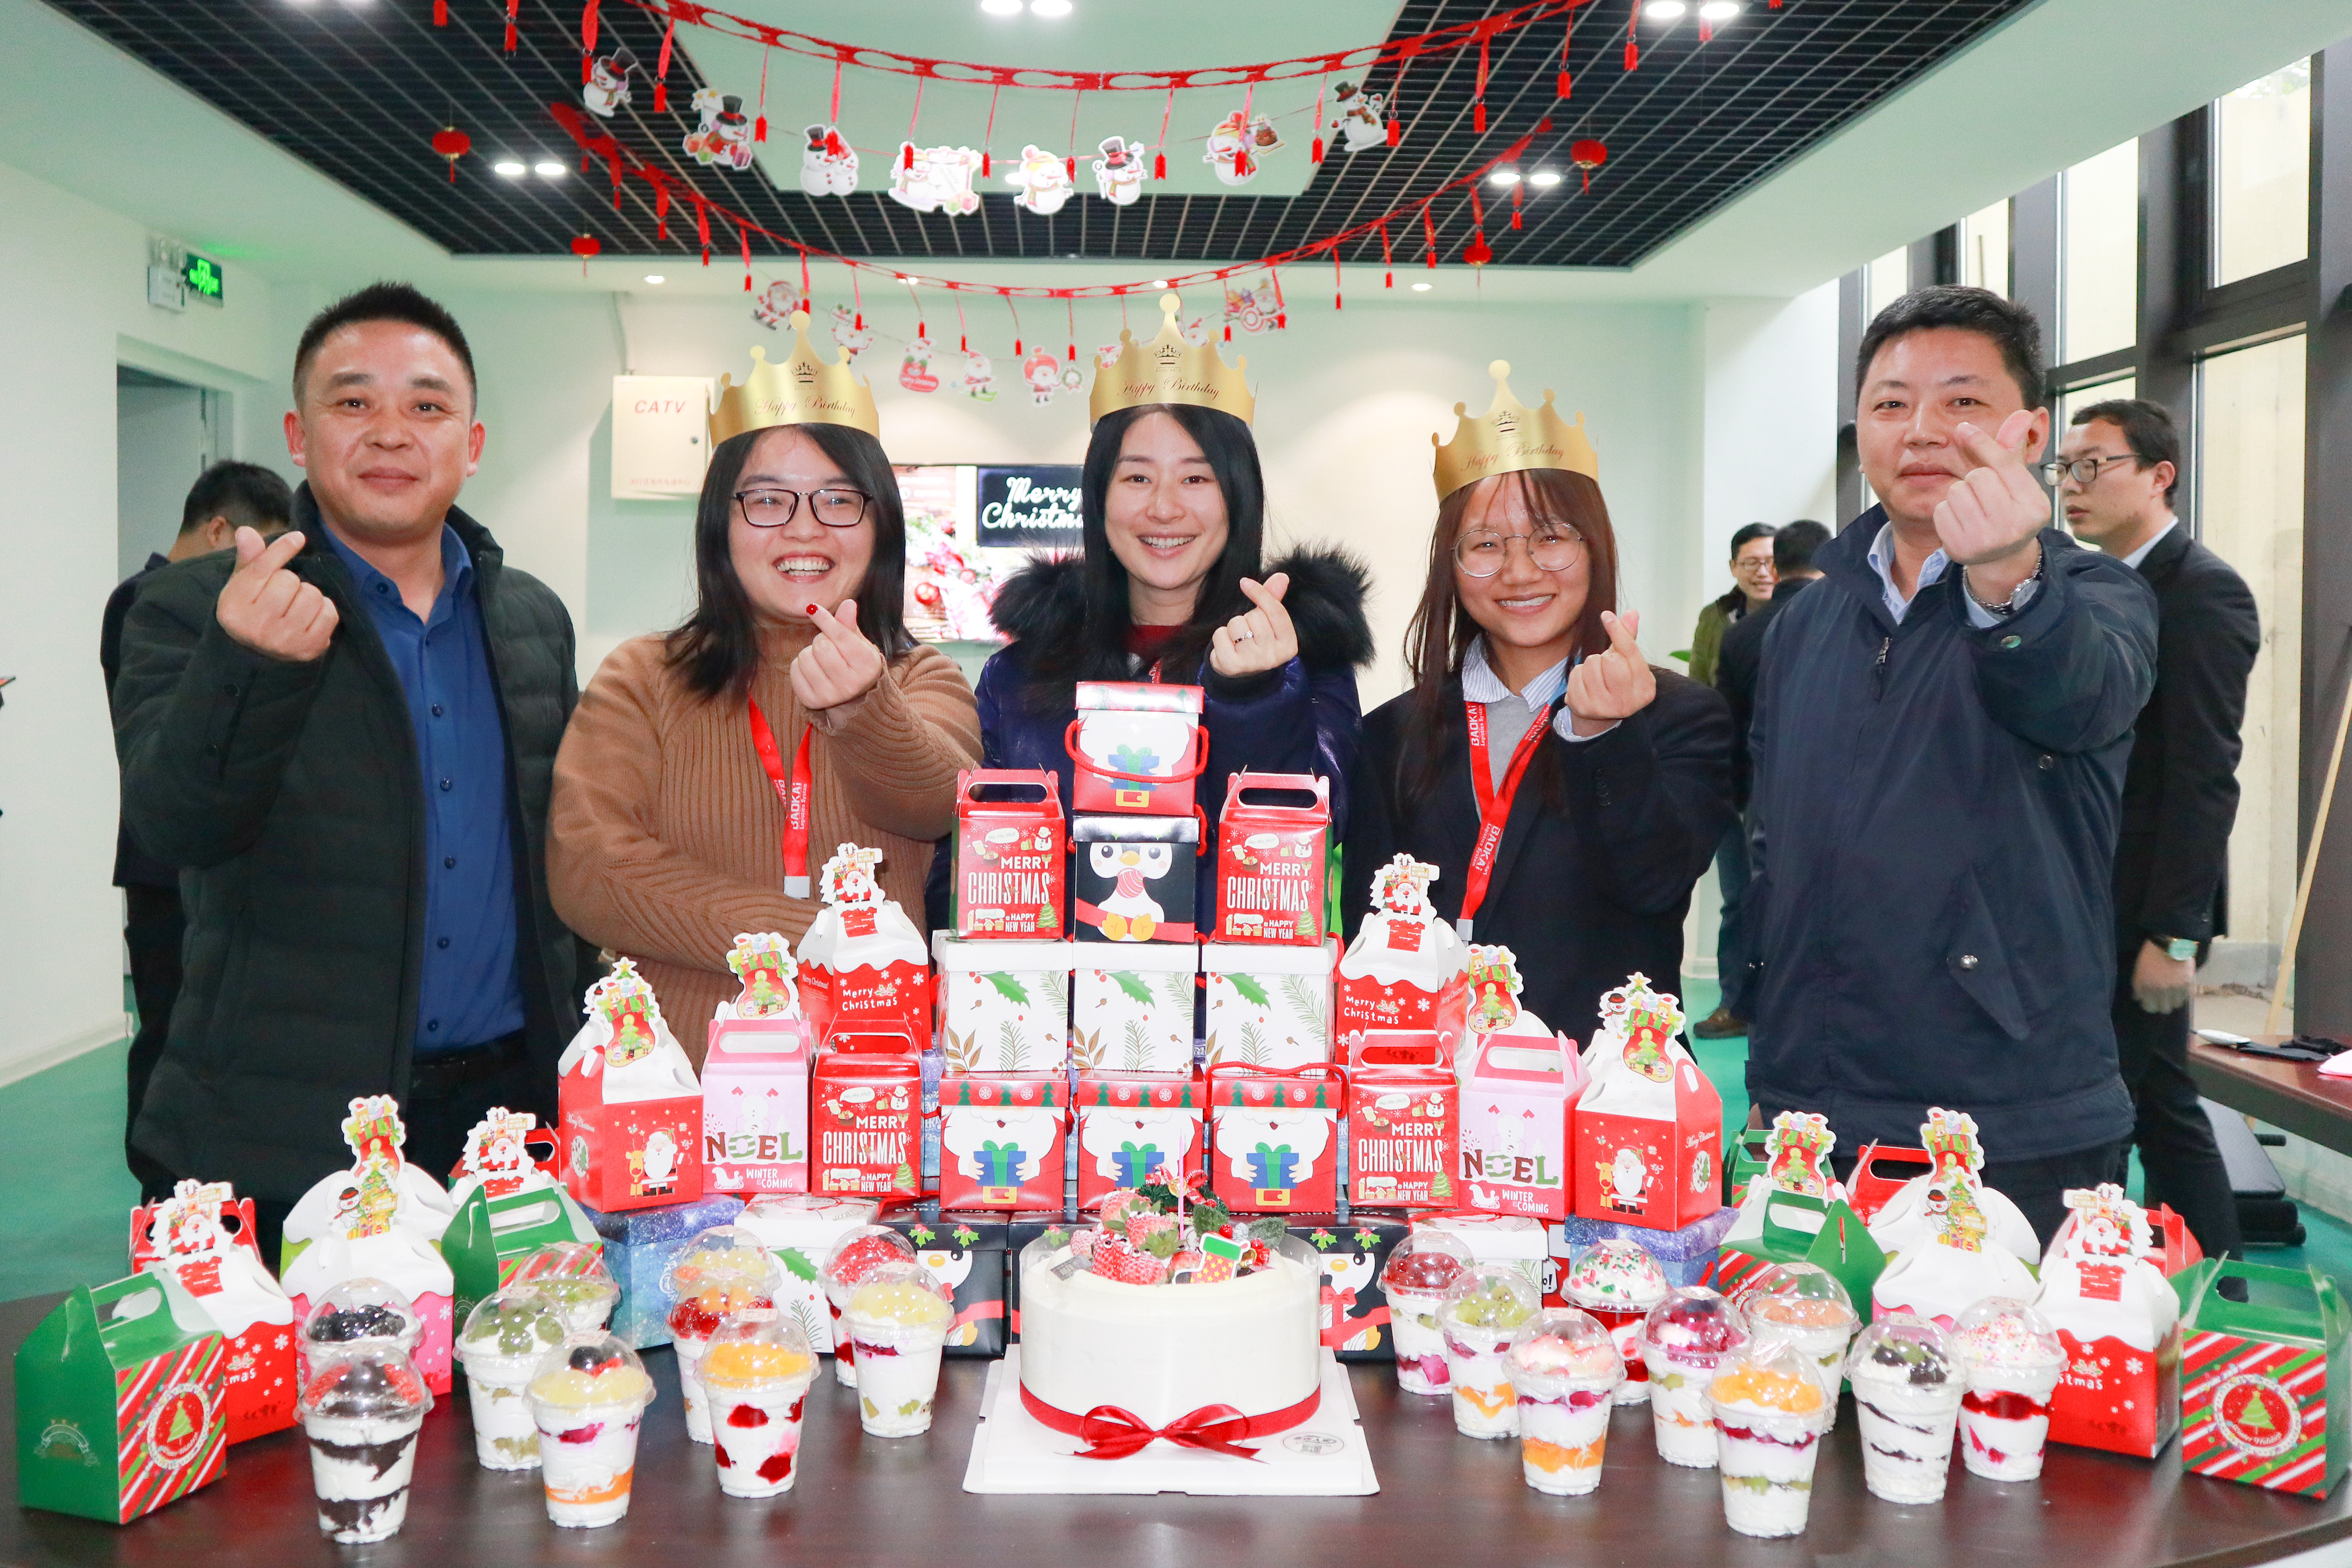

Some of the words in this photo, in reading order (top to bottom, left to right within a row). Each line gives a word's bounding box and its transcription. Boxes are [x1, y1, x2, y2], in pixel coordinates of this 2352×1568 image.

[1117, 379, 1156, 398] Happy
[1163, 376, 1220, 400] Birthday
[634, 400, 686, 414] CATV
[754, 397, 796, 416] Happy
[805, 396, 855, 418] Birthday
[1460, 451, 1499, 471] Happy
[1506, 441, 1564, 460] Birthday
[1006, 476, 1083, 511] Merry
[981, 502, 1084, 529] Christm
[1001, 855, 1051, 869] MERRY
[1260, 861, 1309, 876] MERRY
[968, 872, 1050, 904] CHRISTMAS
[1227, 876, 1310, 912] CHRISTMAS
[1005, 921, 1018, 932] NEW
[1020, 921, 1035, 932] YEAR
[1263, 928, 1277, 939] NEW
[1279, 928, 1293, 939] YEAR
[843, 988, 873, 998] Merry
[842, 997, 897, 1011] Christmas
[1346, 995, 1376, 1010] Merry
[1344, 1007, 1399, 1024] Christmas
[856, 1115, 907, 1129] MERRY
[1392, 1122, 1444, 1136] MERRY
[705, 1132, 803, 1162] NOEL
[823, 1131, 907, 1164] CHRISTMAS
[1358, 1139, 1443, 1173] CHRISTMAS
[746, 1168, 778, 1179] WINTER
[1462, 1149, 1559, 1185] NOEL
[761, 1179, 793, 1188] COMING
[861, 1182, 875, 1192] NEW
[876, 1182, 892, 1192] YEAR
[1398, 1190, 1411, 1201] NEW
[1413, 1190, 1429, 1201] YEAR
[1502, 1189, 1534, 1202] WINTER
[1517, 1201, 1549, 1214] COMING
[2058, 1373, 2103, 1390] stmas
